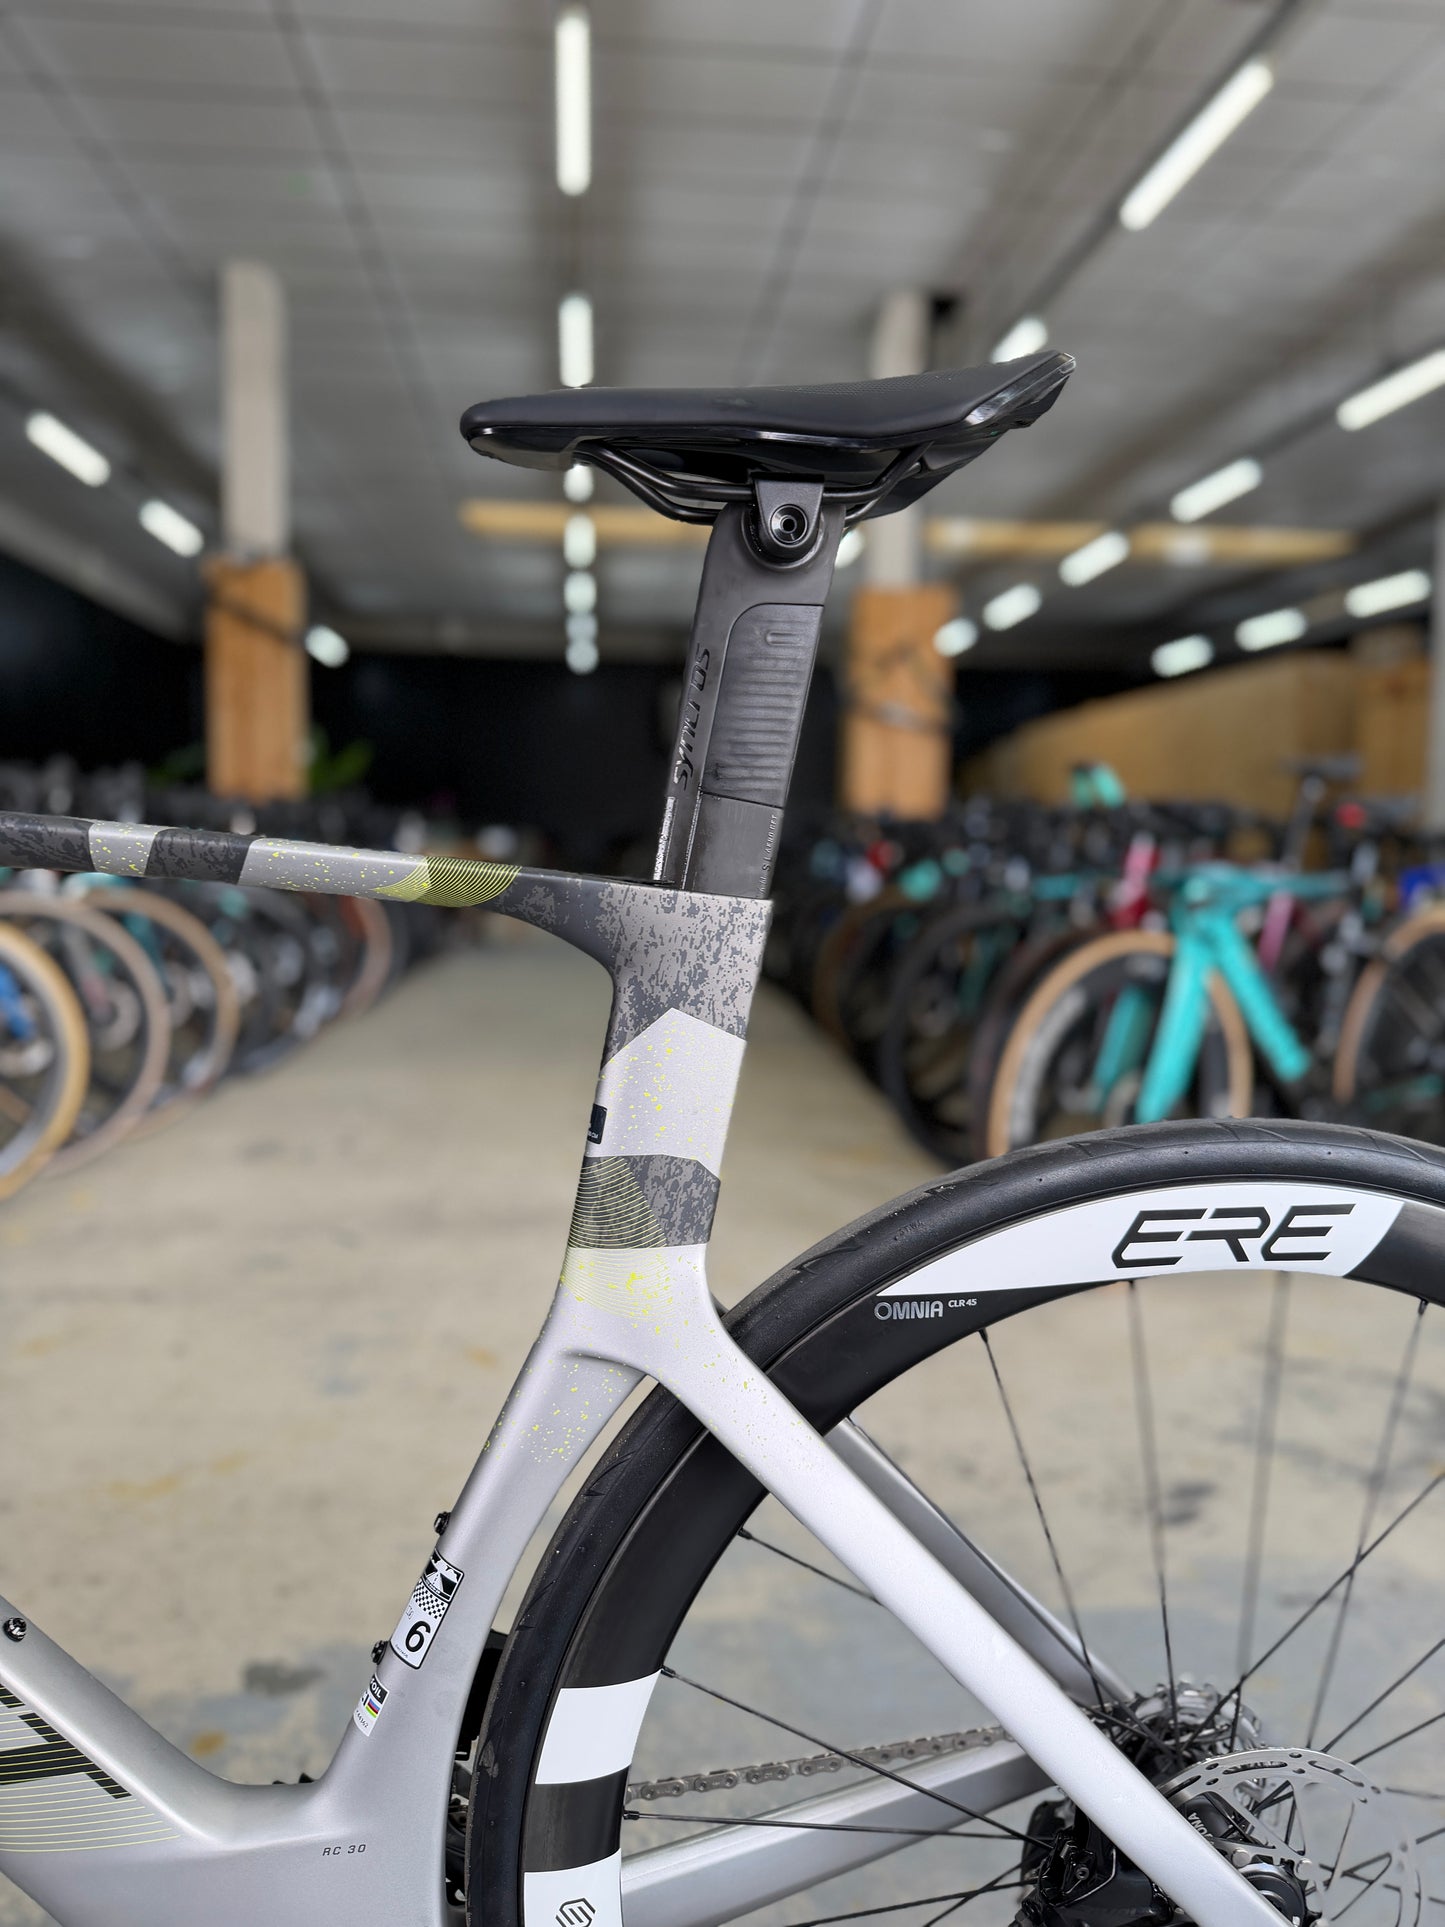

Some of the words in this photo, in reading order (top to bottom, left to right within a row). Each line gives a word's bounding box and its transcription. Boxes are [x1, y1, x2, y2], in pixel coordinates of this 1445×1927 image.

[1111, 1203, 1356, 1269] ERE
[874, 1300, 944, 1321] OMNIA
[948, 1300, 966, 1308] CLR
[966, 1298, 978, 1306] 45
[405, 1620, 431, 1653] 6
[322, 1846, 342, 1857] RC
[347, 1844, 367, 1854] 30
